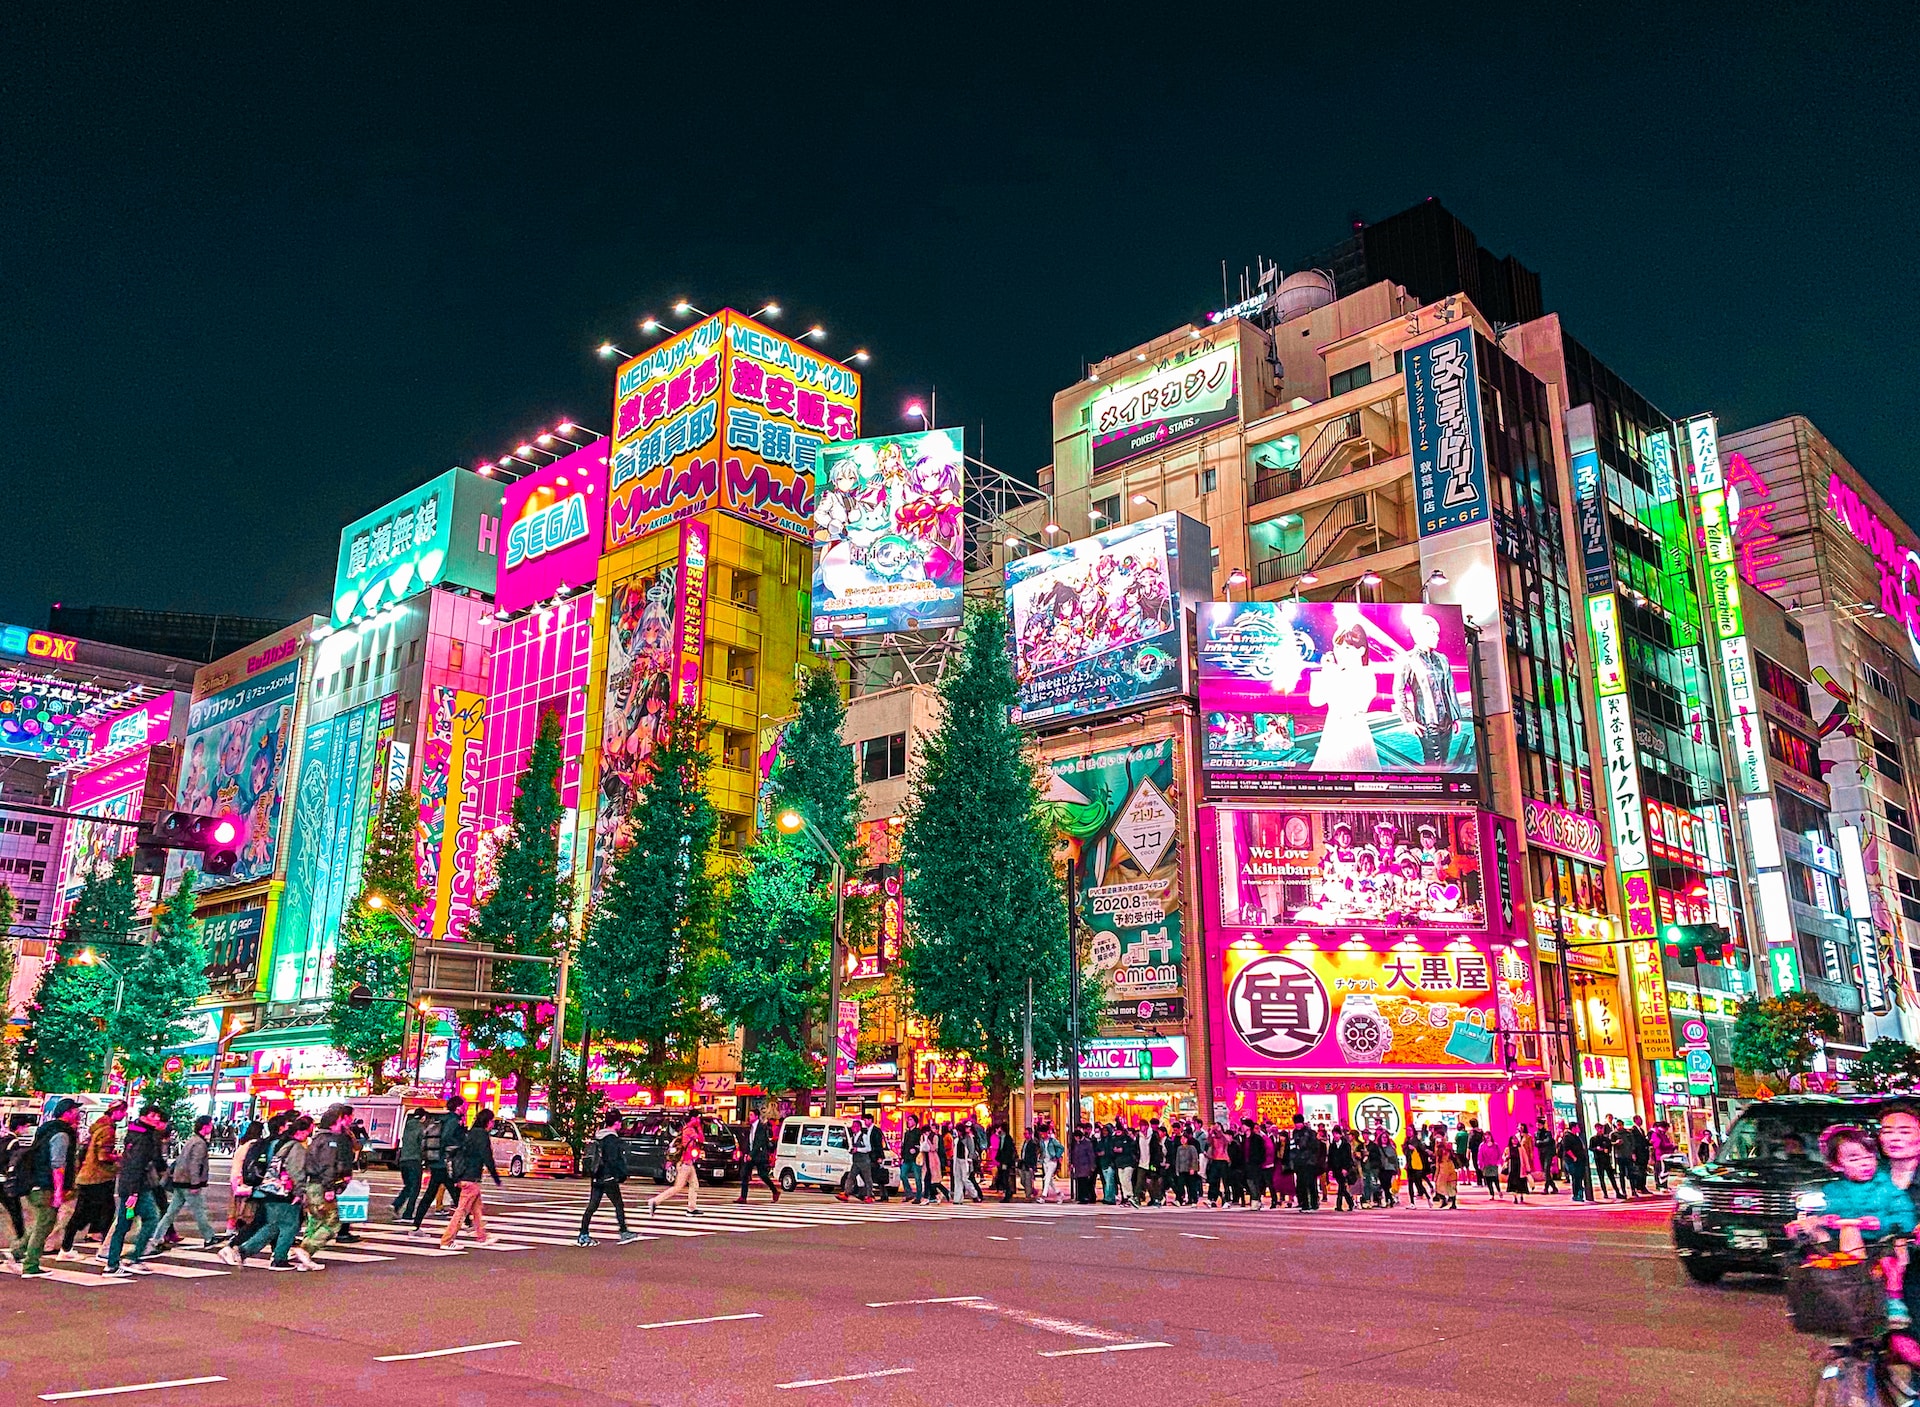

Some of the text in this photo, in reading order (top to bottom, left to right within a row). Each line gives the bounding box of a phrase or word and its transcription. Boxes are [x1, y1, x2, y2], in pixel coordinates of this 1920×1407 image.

[618, 355, 719, 438] 激安販売
[733, 358, 856, 440] 激安販売
[1099, 362, 1227, 432] メイドカジノ
[1413, 361, 1428, 447] トレーディングカードゲーム
[613, 402, 717, 488] 高額買取
[728, 407, 816, 474] 高額買
[1131, 432, 1155, 449] POKER
[1696, 426, 1716, 485] スーパービル
[610, 459, 718, 541] Mulan
[1419, 460, 1436, 514] 秋葉原店
[507, 493, 588, 568] SEGA
[649, 514, 673, 531] AKIBA
[738, 502, 808, 536] ムーラン AKIBA
[478, 514, 500, 555] H
[686, 567, 703, 579] DVD
[1707, 521, 1732, 632] Yellow Submarine
[686, 586, 702, 598] ゲーム
[687, 597, 700, 606] CD
[684, 615, 701, 626] アニメ
[246, 638, 296, 674] ビックカメラ
[1600, 620, 1614, 666] りらくる
[1727, 639, 1740, 648] 5F
[200, 674, 230, 693] Sofmap
[1015, 671, 1094, 697] あ、冒険をはじめよう。
[203, 690, 246, 721] ソフマップ
[1209, 759, 1260, 767] 2019.10.30
[332, 740, 358, 897] 電子マネー使えます
[1130, 807, 1165, 823] アトリエ
[1133, 831, 1161, 850] ココ
[1525, 803, 1601, 857] メイドカジノ
[1249, 847, 1309, 859] We Love
[1241, 863, 1320, 875] Akihabara
[1089, 880, 1168, 895] PVC製塗装済み完成品フィギュア
[1094, 895, 1141, 912] 2020.8
[1115, 909, 1164, 925] 予約受付中
[1115, 965, 1177, 983] amiami
[1335, 956, 1488, 990] チケット 大黒屋
[1857, 921, 1884, 1008] GALLERIA
[1648, 940, 1667, 1025] TAX FREE
[1120, 1007, 1136, 1015] more
[1242, 971, 1322, 1045] 質
[1599, 997, 1614, 1046] ルノアール
[1689, 1026, 1702, 1037] 40
[1078, 1049, 1120, 1068] OMIC
[1691, 1055, 1702, 1069] P
[699, 1075, 731, 1090] ラーメン
[1310, 1113, 1332, 1121] 大黒屋
